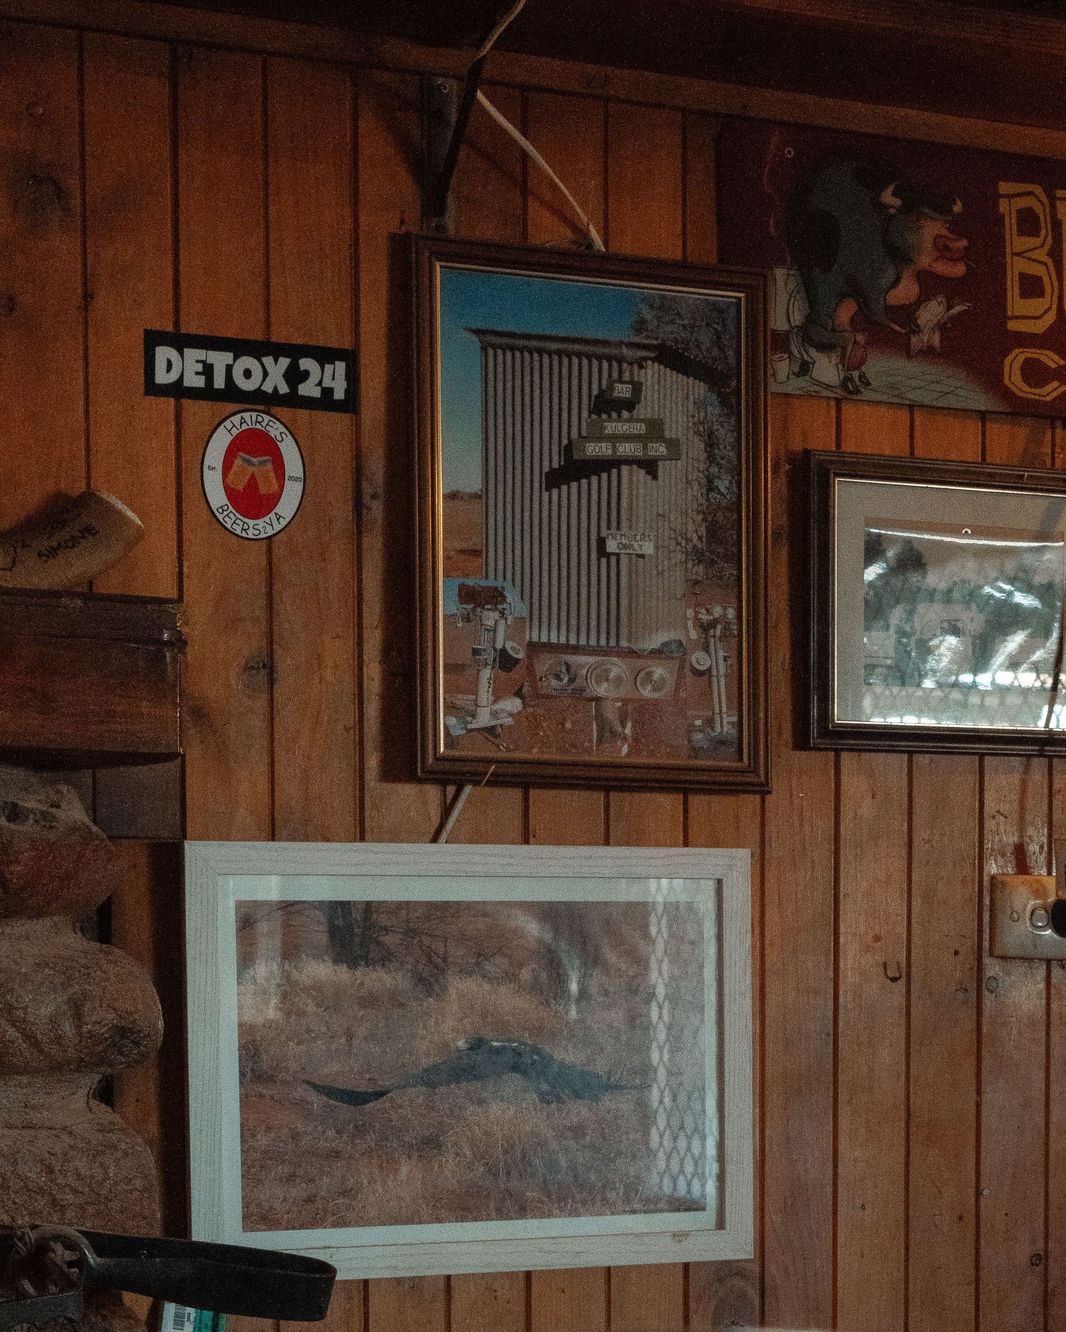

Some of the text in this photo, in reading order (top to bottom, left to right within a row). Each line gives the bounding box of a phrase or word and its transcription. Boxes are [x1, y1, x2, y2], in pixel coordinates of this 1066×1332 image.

[154, 345, 348, 400] DETOX 24
[613, 384, 632, 397] BAR
[222, 413, 289, 444] HAIRE'S
[604, 422, 646, 433] KULGERA
[587, 444, 611, 455] GOLF
[617, 444, 642, 455] CLUB
[287, 474, 303, 483] 2020
